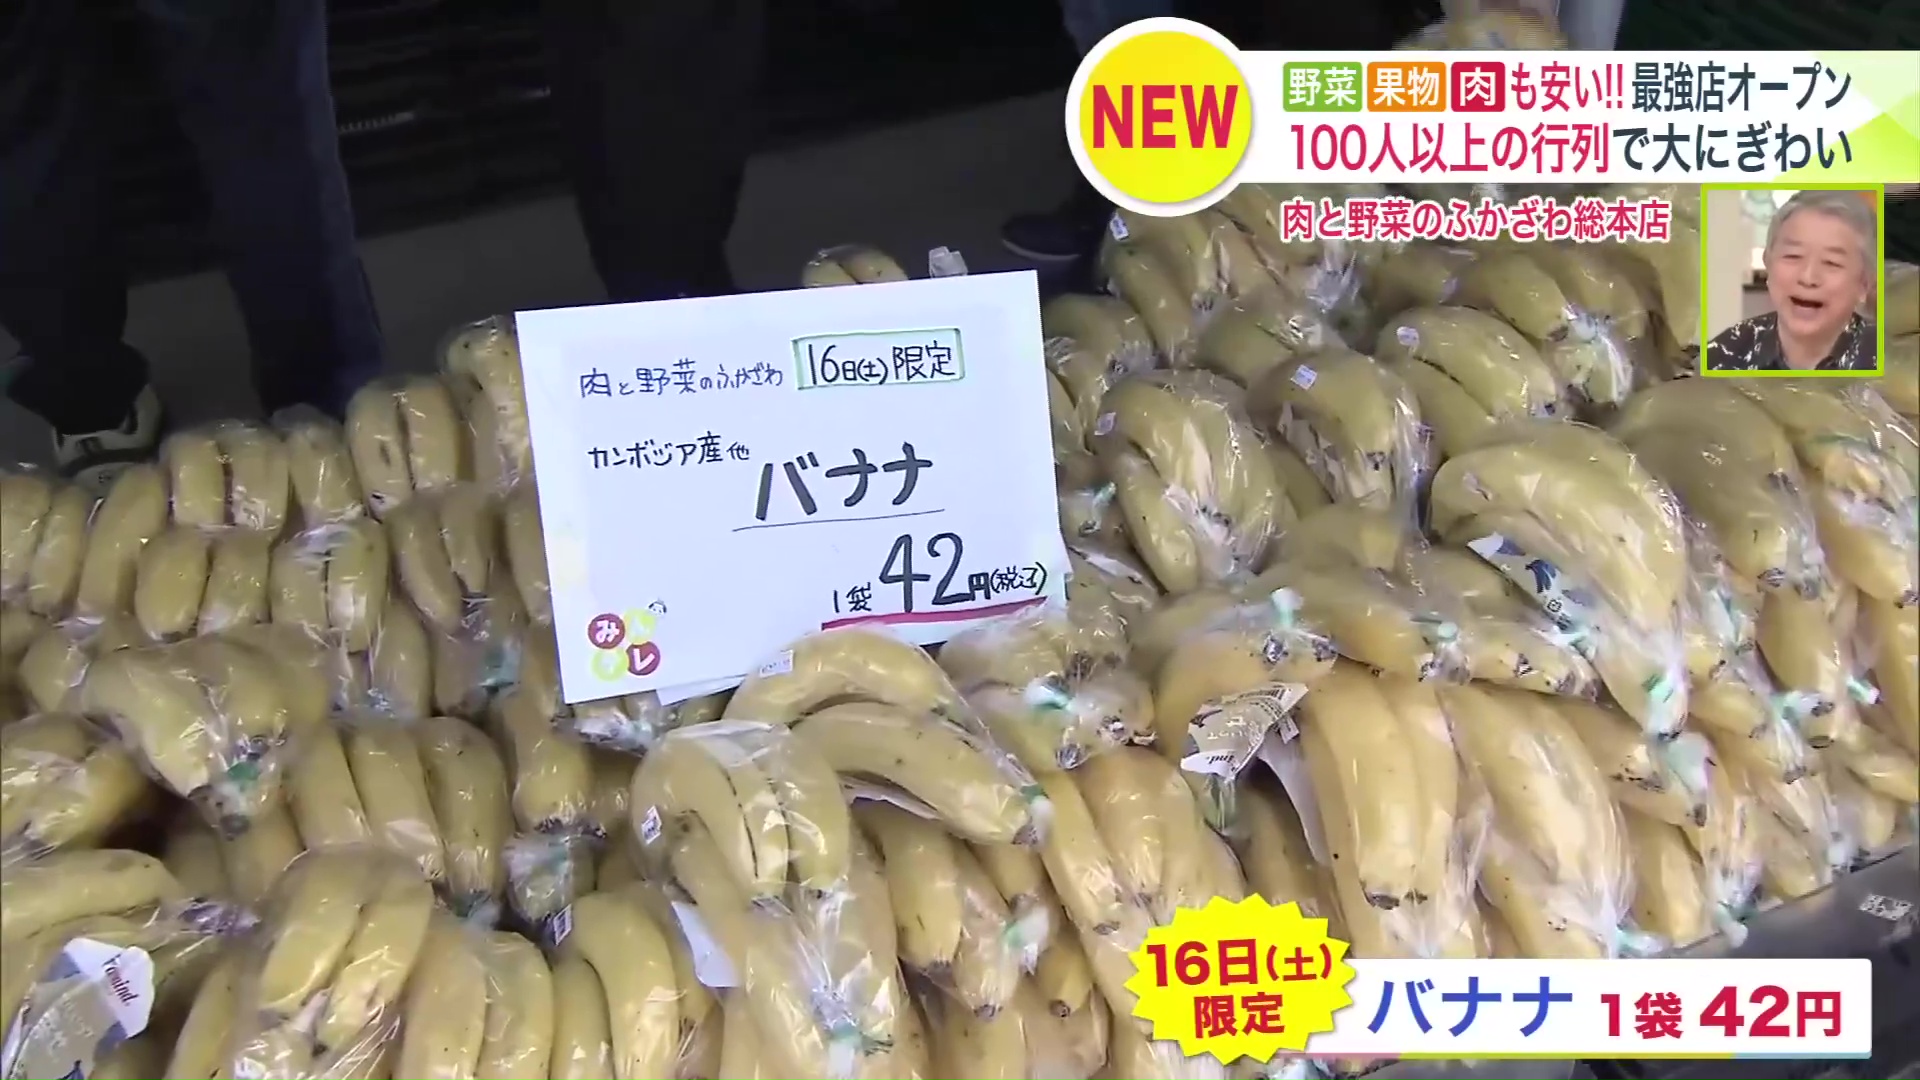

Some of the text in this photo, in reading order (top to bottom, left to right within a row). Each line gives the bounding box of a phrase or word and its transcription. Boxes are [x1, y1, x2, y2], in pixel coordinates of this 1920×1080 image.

[580, 358, 783, 398] 肉と野菜のふかざわ
[755, 441, 932, 521] バナナ
